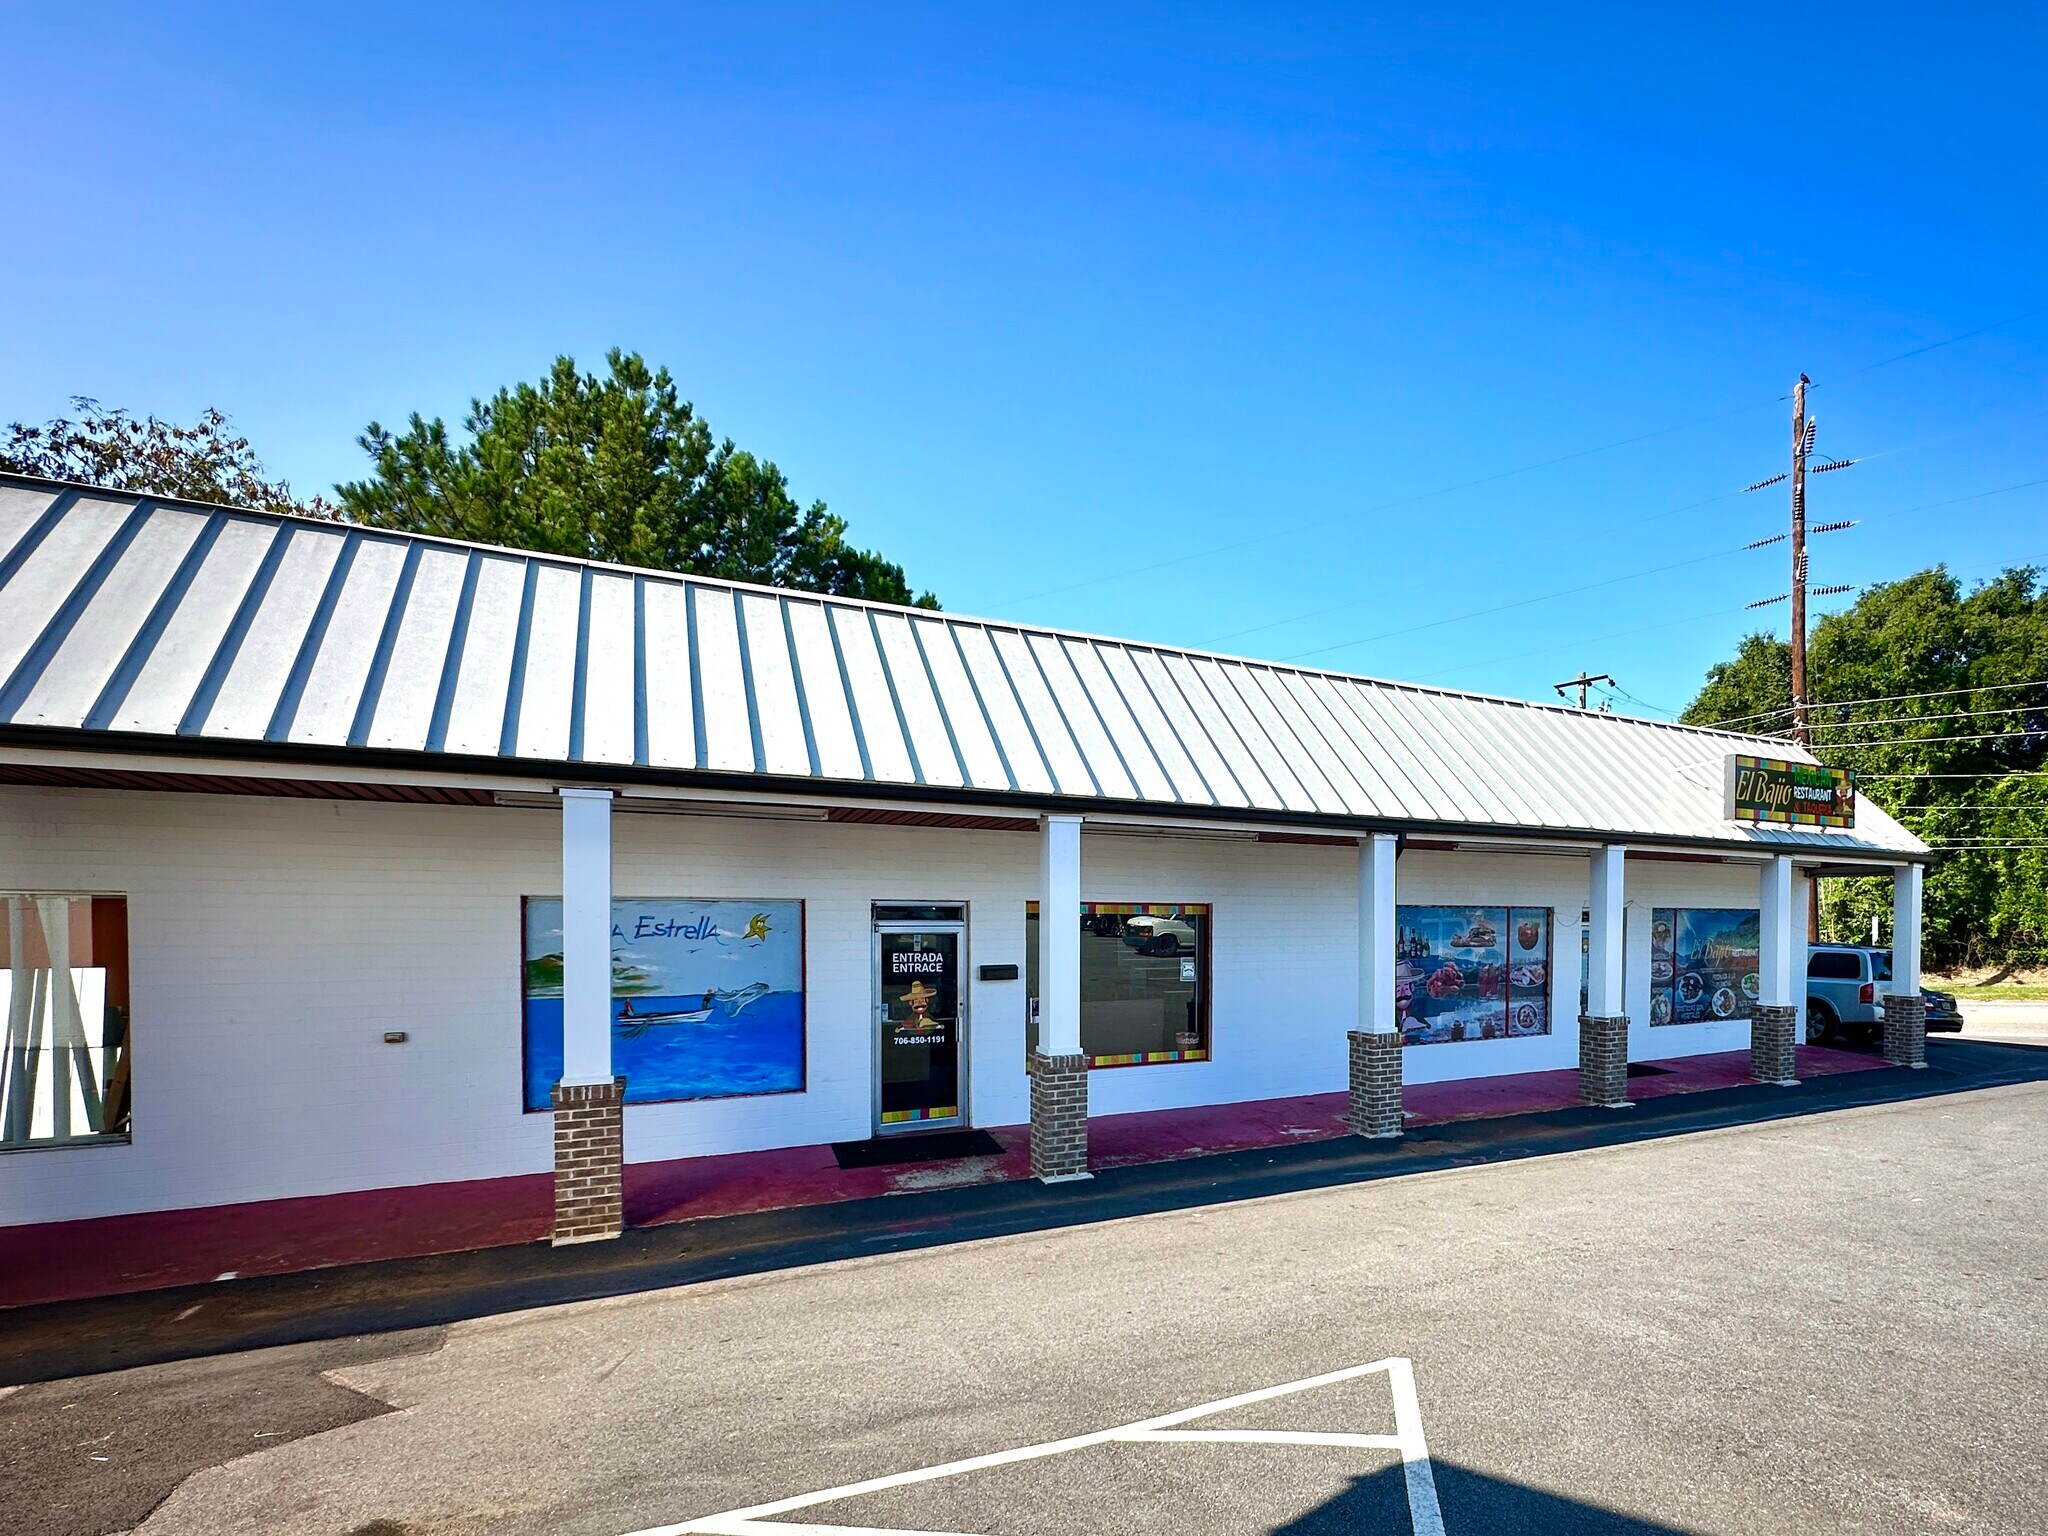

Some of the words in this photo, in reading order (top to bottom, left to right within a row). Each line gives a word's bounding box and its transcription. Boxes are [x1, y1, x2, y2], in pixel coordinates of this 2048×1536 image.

[1736, 770, 1756, 801] El
[1794, 766, 1832, 788] MEXICAN
[1793, 785, 1832, 802] RESTAURANT
[1793, 802, 1800, 813] &
[612, 924, 635, 945] A
[892, 953, 944, 963] ENTRADA
[1690, 939, 1703, 960] El
[892, 963, 943, 973] ENTRACE
[893, 1035, 945, 1045] 706-850-1191
